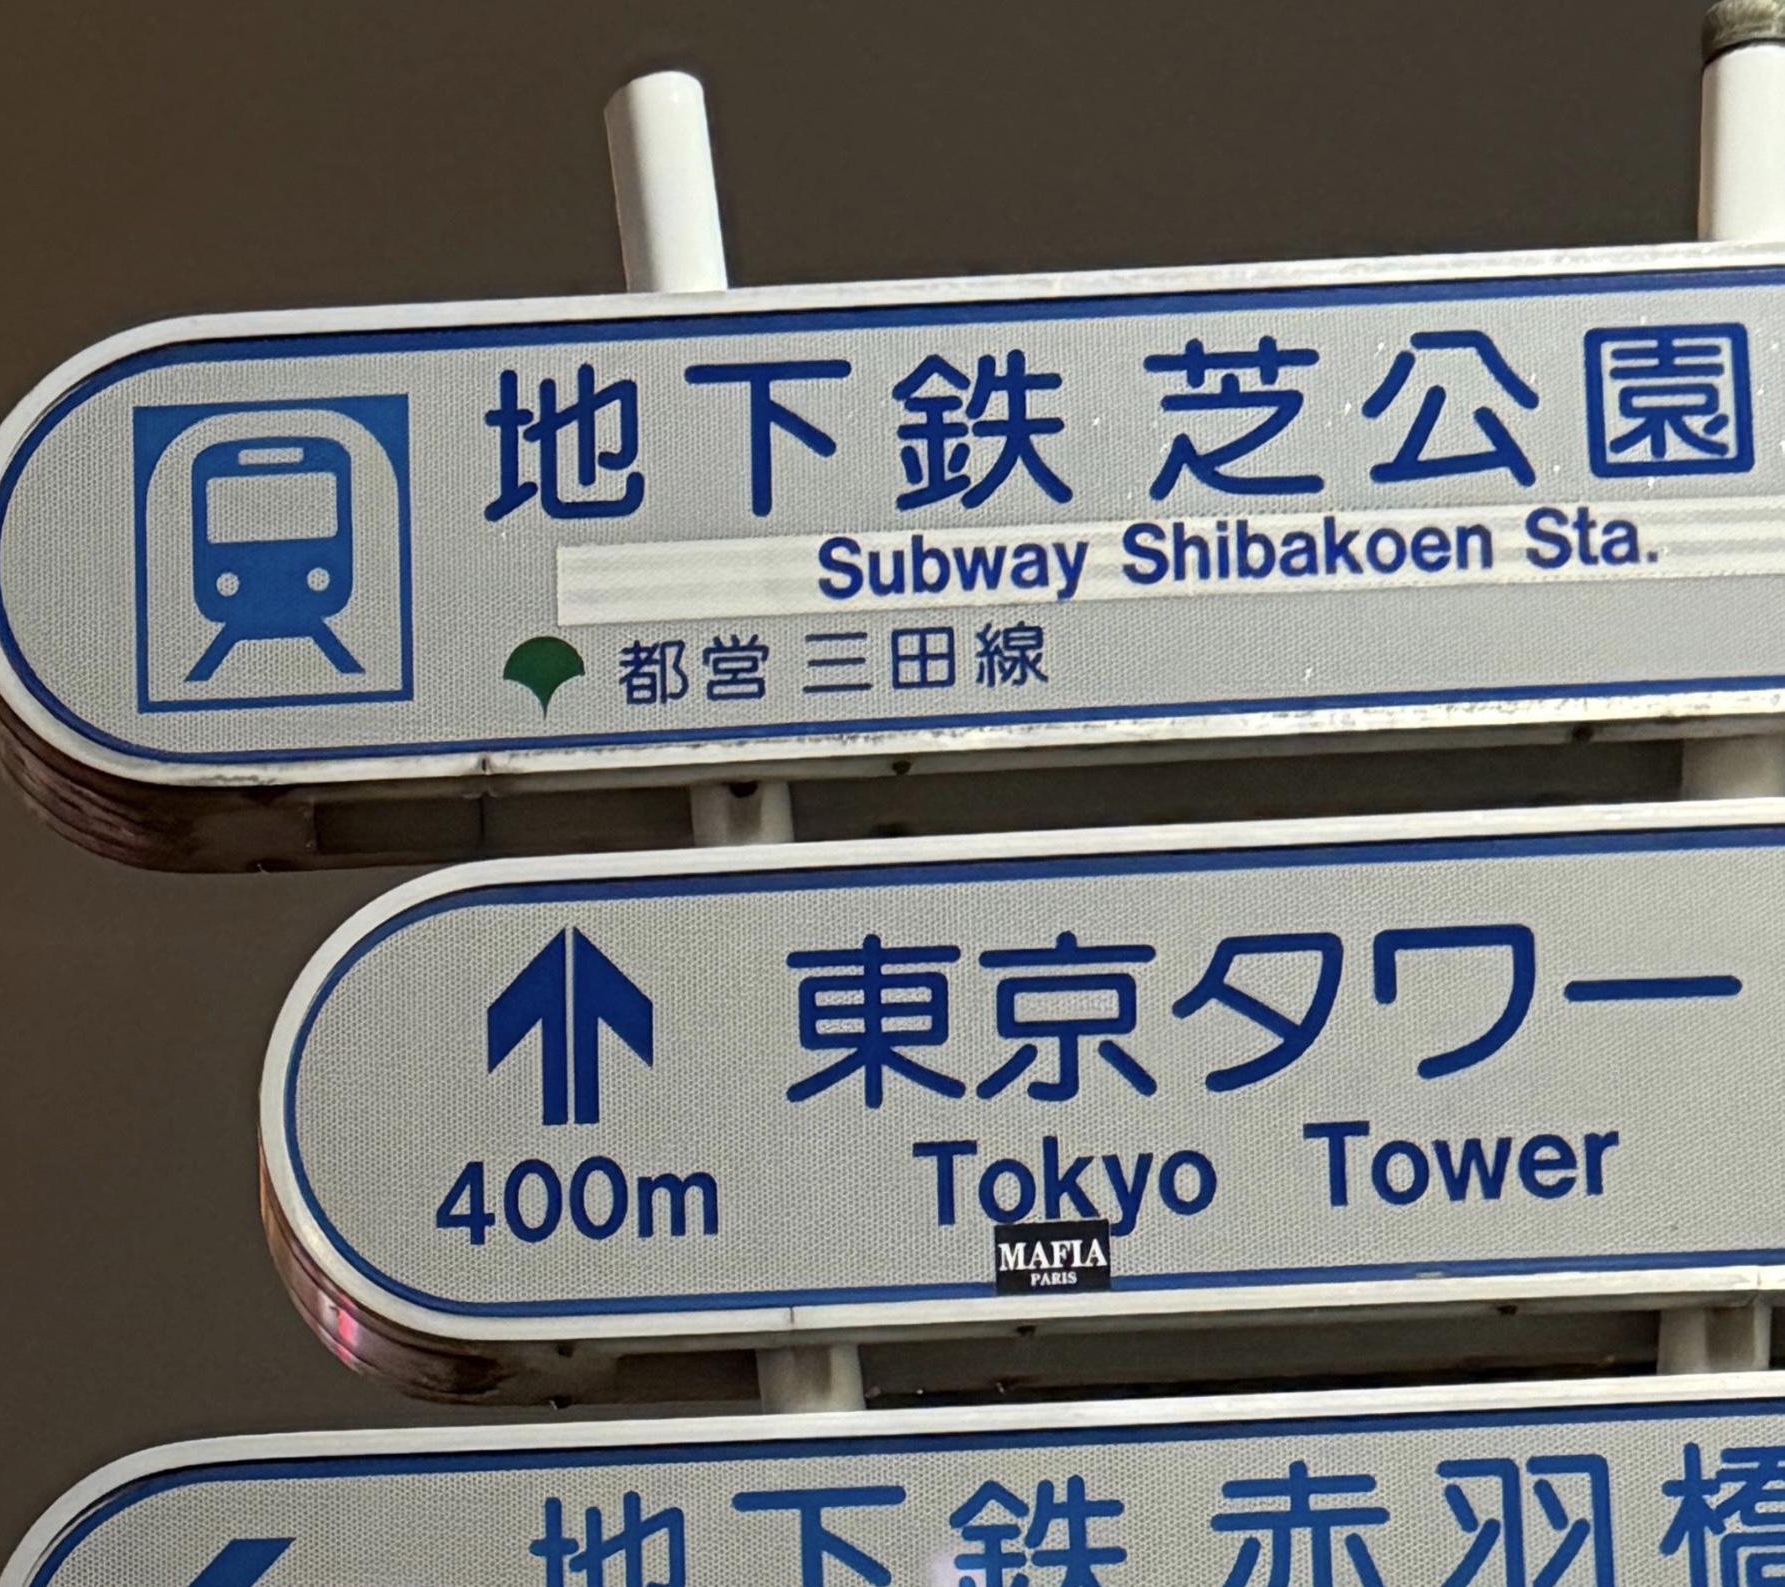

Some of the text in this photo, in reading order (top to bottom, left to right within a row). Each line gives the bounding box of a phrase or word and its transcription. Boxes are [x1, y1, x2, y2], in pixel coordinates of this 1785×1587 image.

[484, 322, 1755, 522] 地下鉄 芝公園
[817, 507, 1658, 600] Subway Shibakoen Sta.
[618, 621, 1050, 706] 都営 三田線
[786, 923, 1742, 1109] 東京タワー
[435, 1154, 719, 1246] 400m
[912, 1121, 1619, 1237] Tokyo Tower
[998, 1238, 1108, 1272] MAFIA
[1030, 1271, 1078, 1287] PARIS
